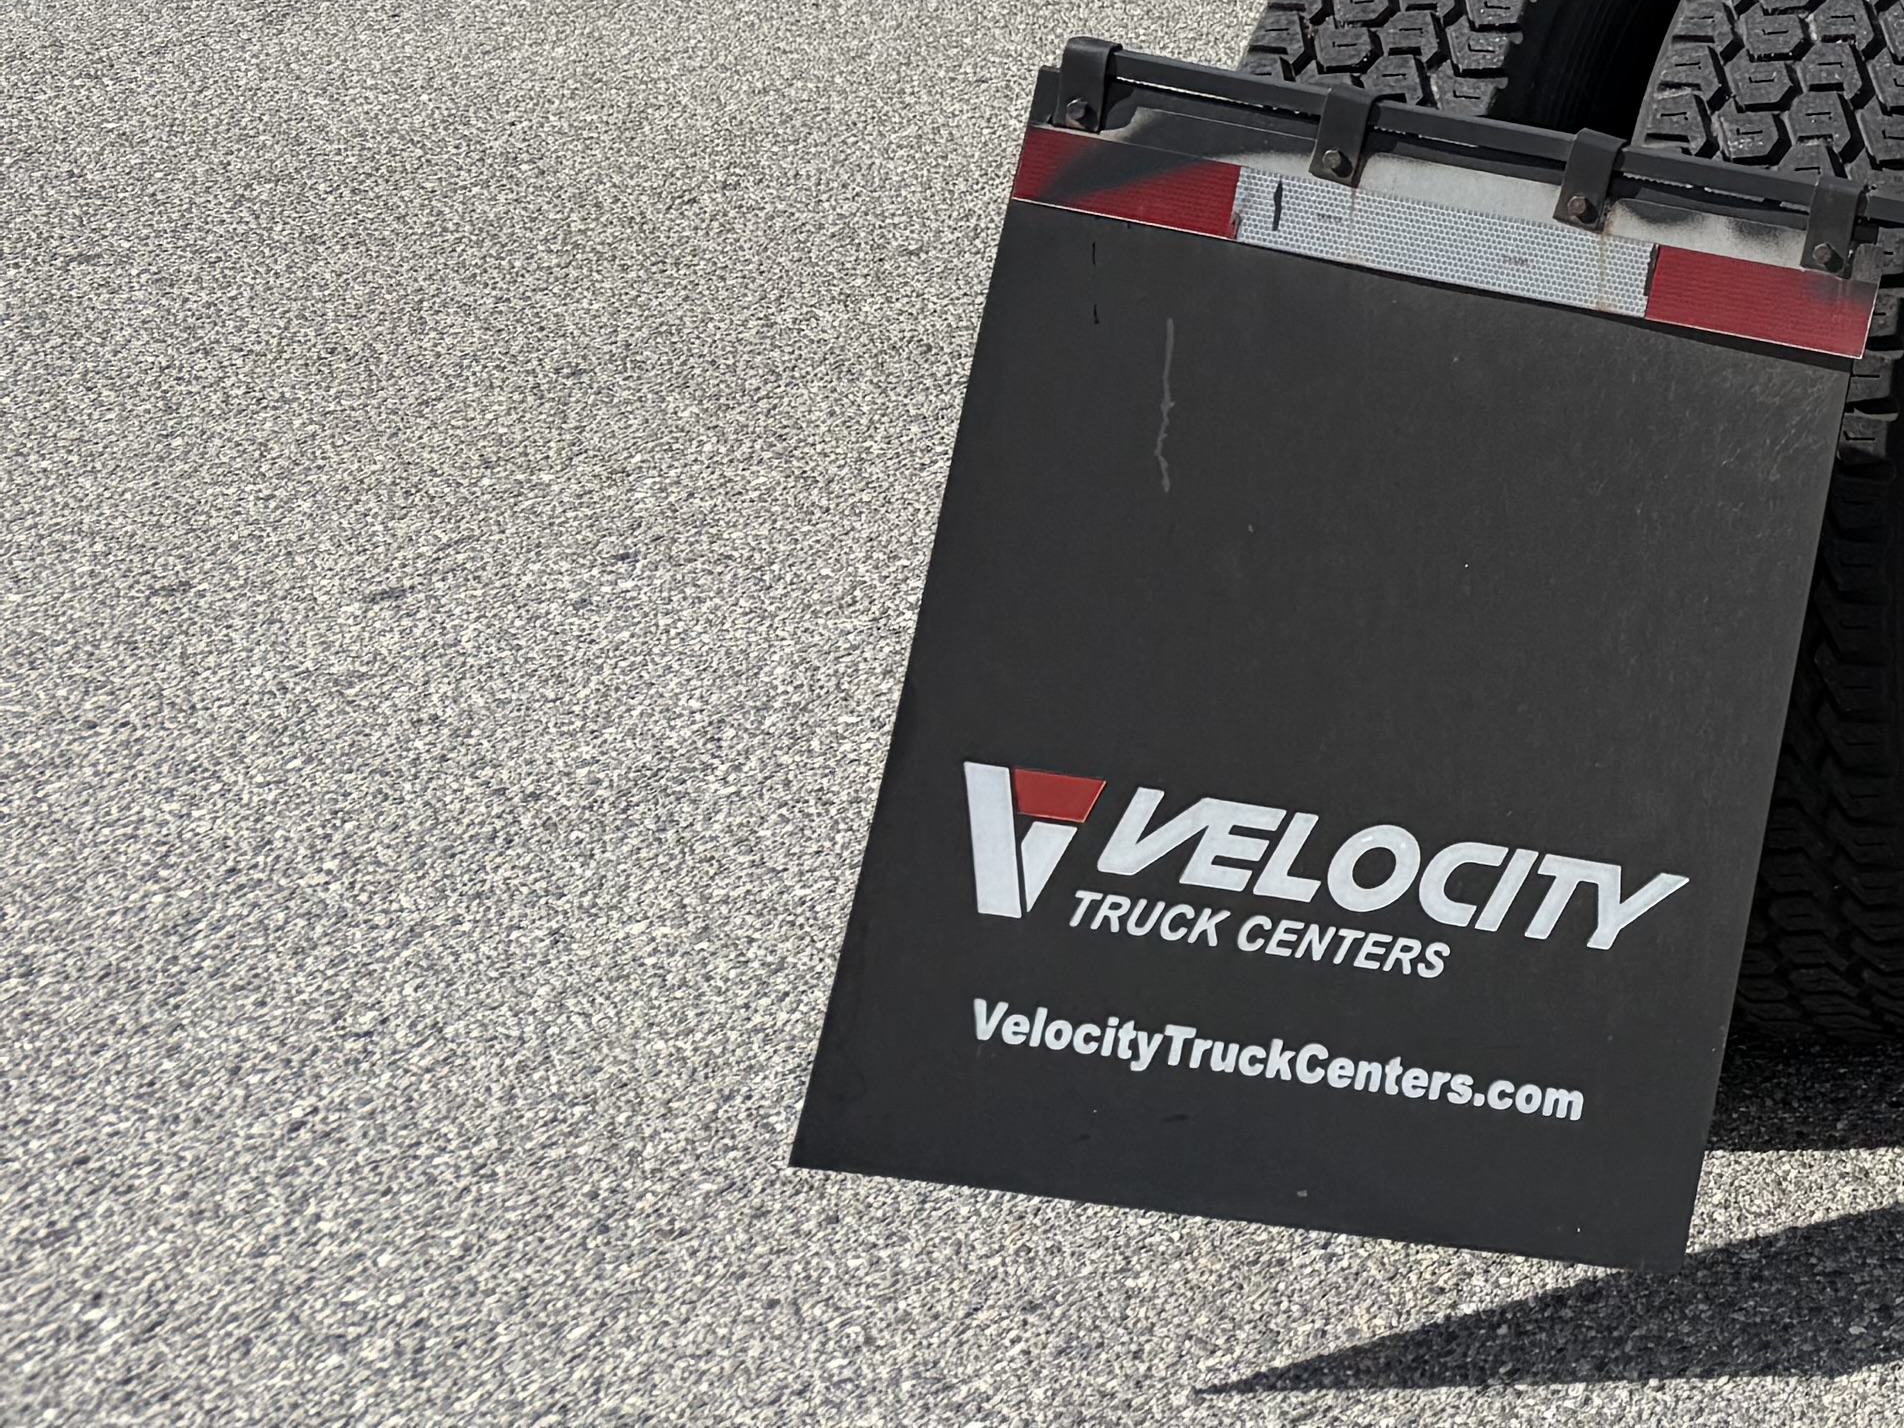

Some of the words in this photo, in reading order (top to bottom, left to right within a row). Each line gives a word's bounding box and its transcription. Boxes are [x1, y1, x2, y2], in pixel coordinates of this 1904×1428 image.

[1095, 786, 1691, 950] VELOCITY
[1068, 889, 1231, 948] TRUCK
[1236, 914, 1451, 980] CENTERS
[972, 997, 1584, 1122] VelocityTruckCenters.com
